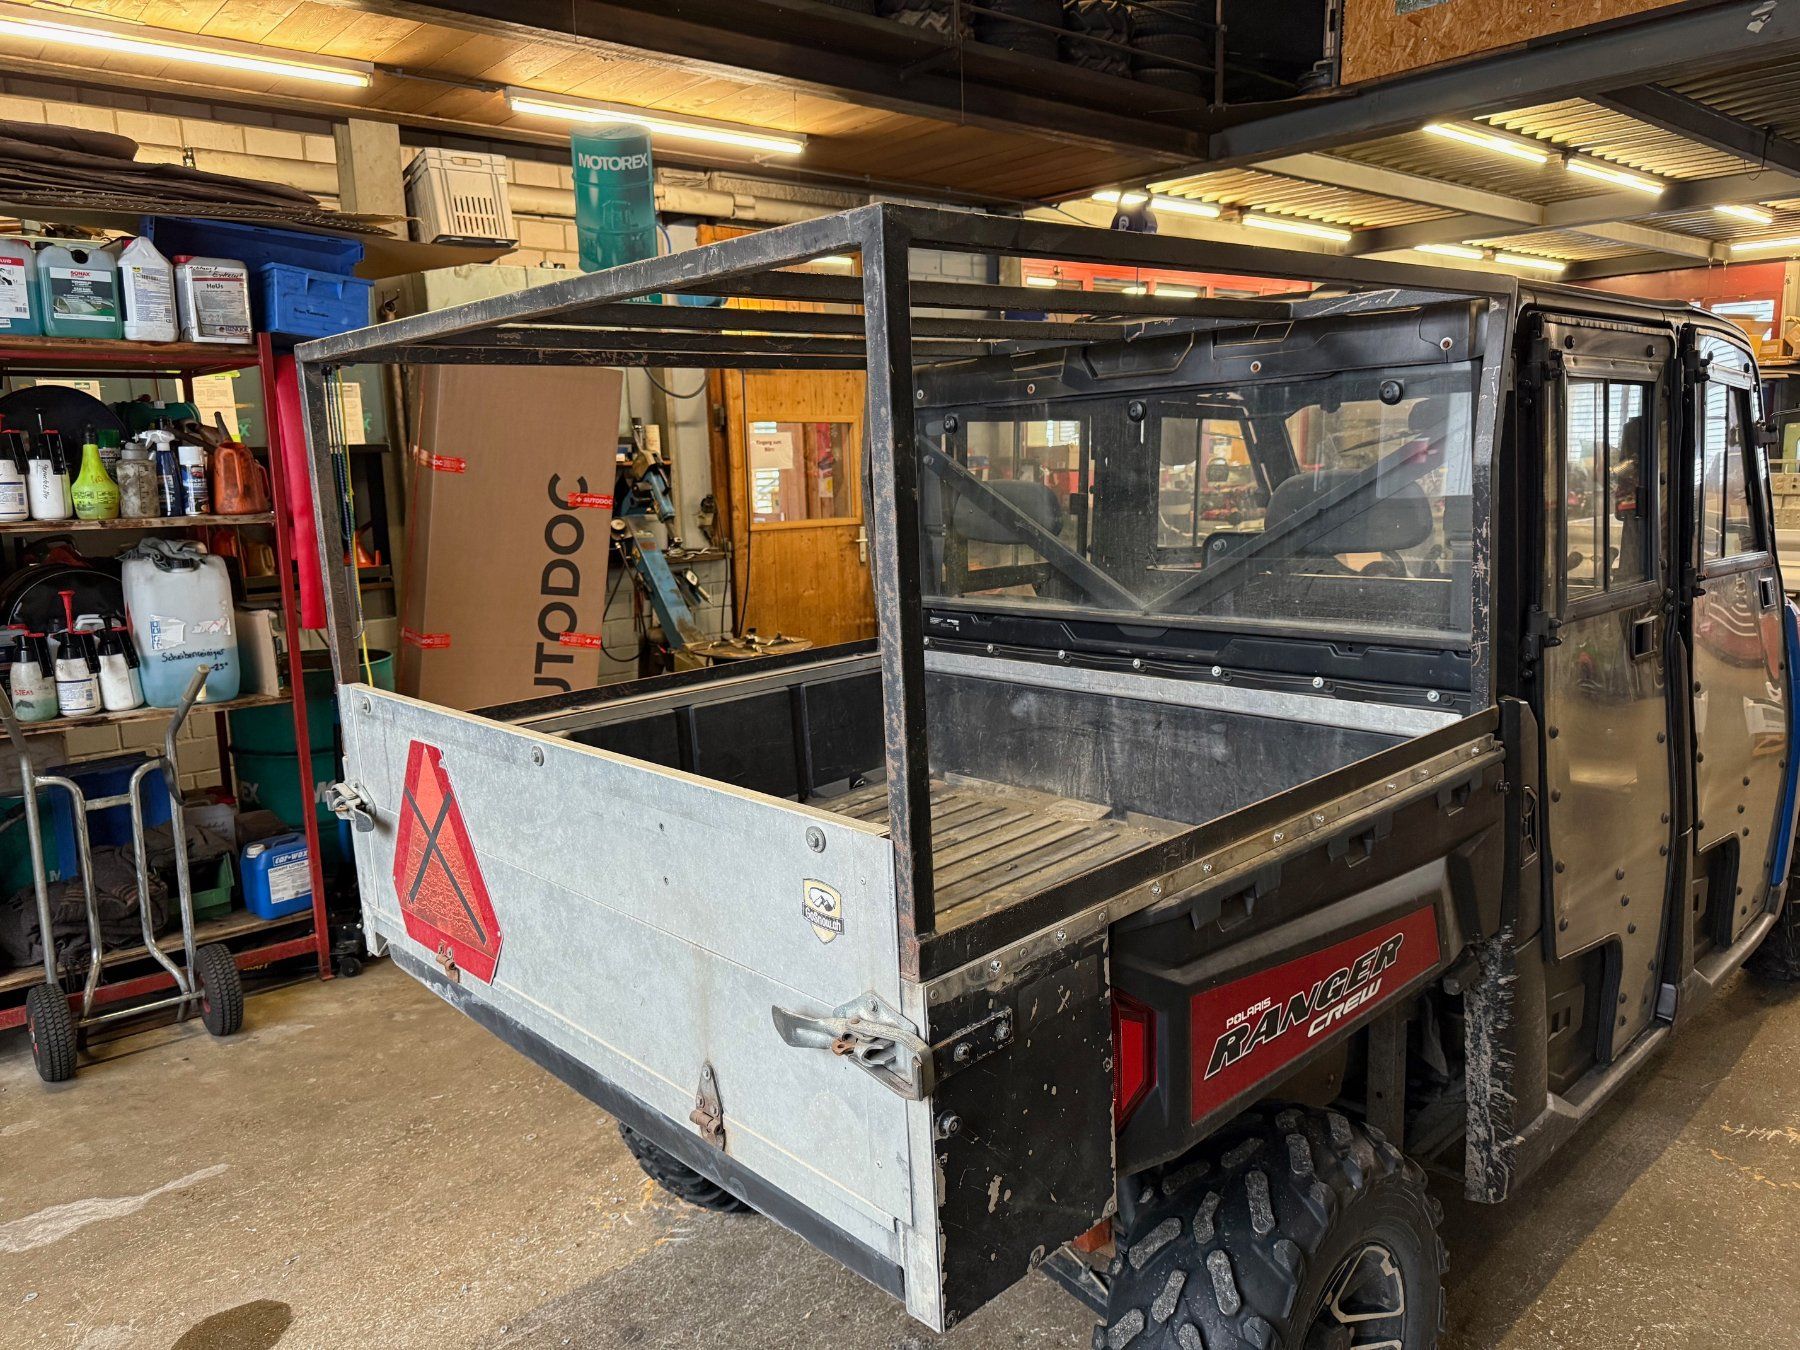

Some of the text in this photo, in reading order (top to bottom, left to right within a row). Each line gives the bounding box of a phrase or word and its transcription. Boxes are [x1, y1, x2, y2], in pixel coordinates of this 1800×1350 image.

[578, 152, 648, 171] MOTOREX
[583, 497, 613, 505] AUTODOC
[274, 850, 308, 865] car-wax
[1204, 932, 1404, 1081] RANGER
[1226, 997, 1272, 1029] POLARIS
[1307, 977, 1382, 1038] CREW
